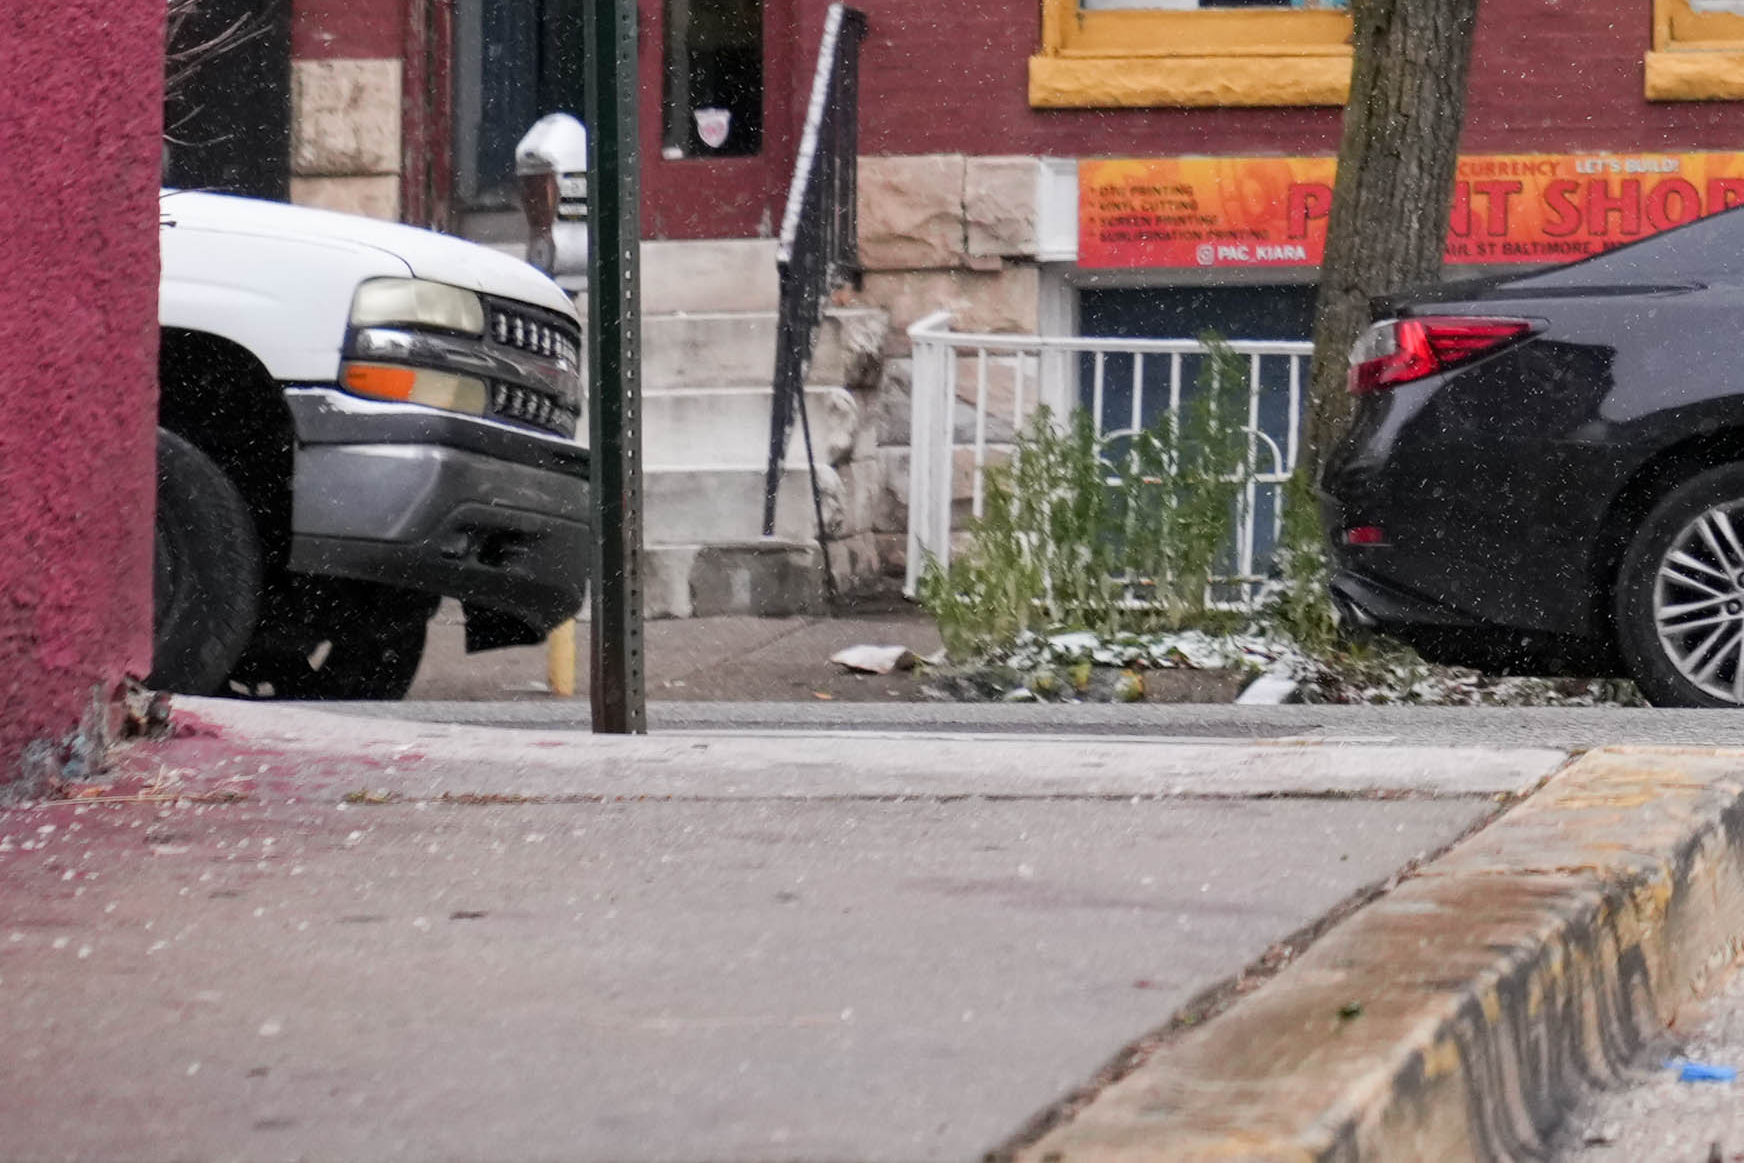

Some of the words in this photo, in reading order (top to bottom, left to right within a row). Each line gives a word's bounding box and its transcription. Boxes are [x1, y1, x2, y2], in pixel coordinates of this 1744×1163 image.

[1458, 161, 1560, 177] CURRENCY
[1575, 158, 1621, 174] LET'S
[1626, 158, 1680, 174] BUILD!
[1217, 243, 1307, 264] PAC_KIARA
[1476, 242, 1497, 256] ST
